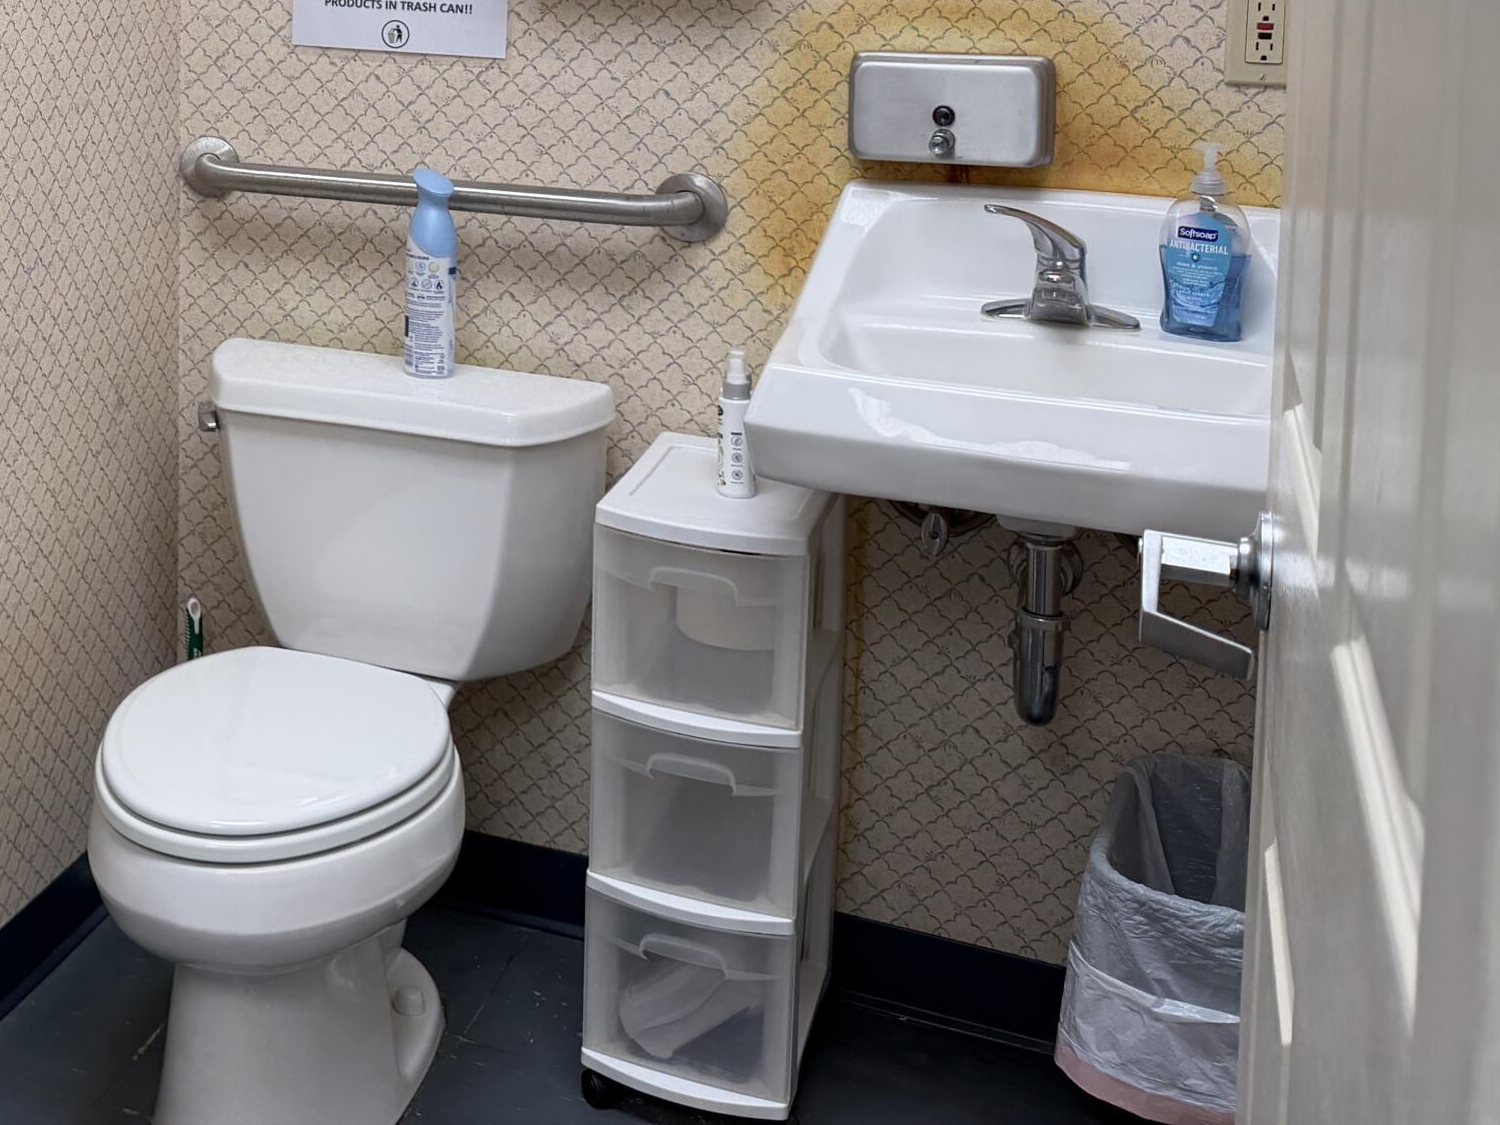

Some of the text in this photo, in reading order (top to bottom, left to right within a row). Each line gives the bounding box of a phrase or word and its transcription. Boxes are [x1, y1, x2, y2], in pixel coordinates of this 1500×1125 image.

[385, 0, 397, 9] IN
[400, 1, 436, 12] TRASH
[440, 3, 473, 14] CAN!!
[1180, 227, 1217, 240] Softsoap
[1169, 239, 1228, 255] ANTIBACTERIAL
